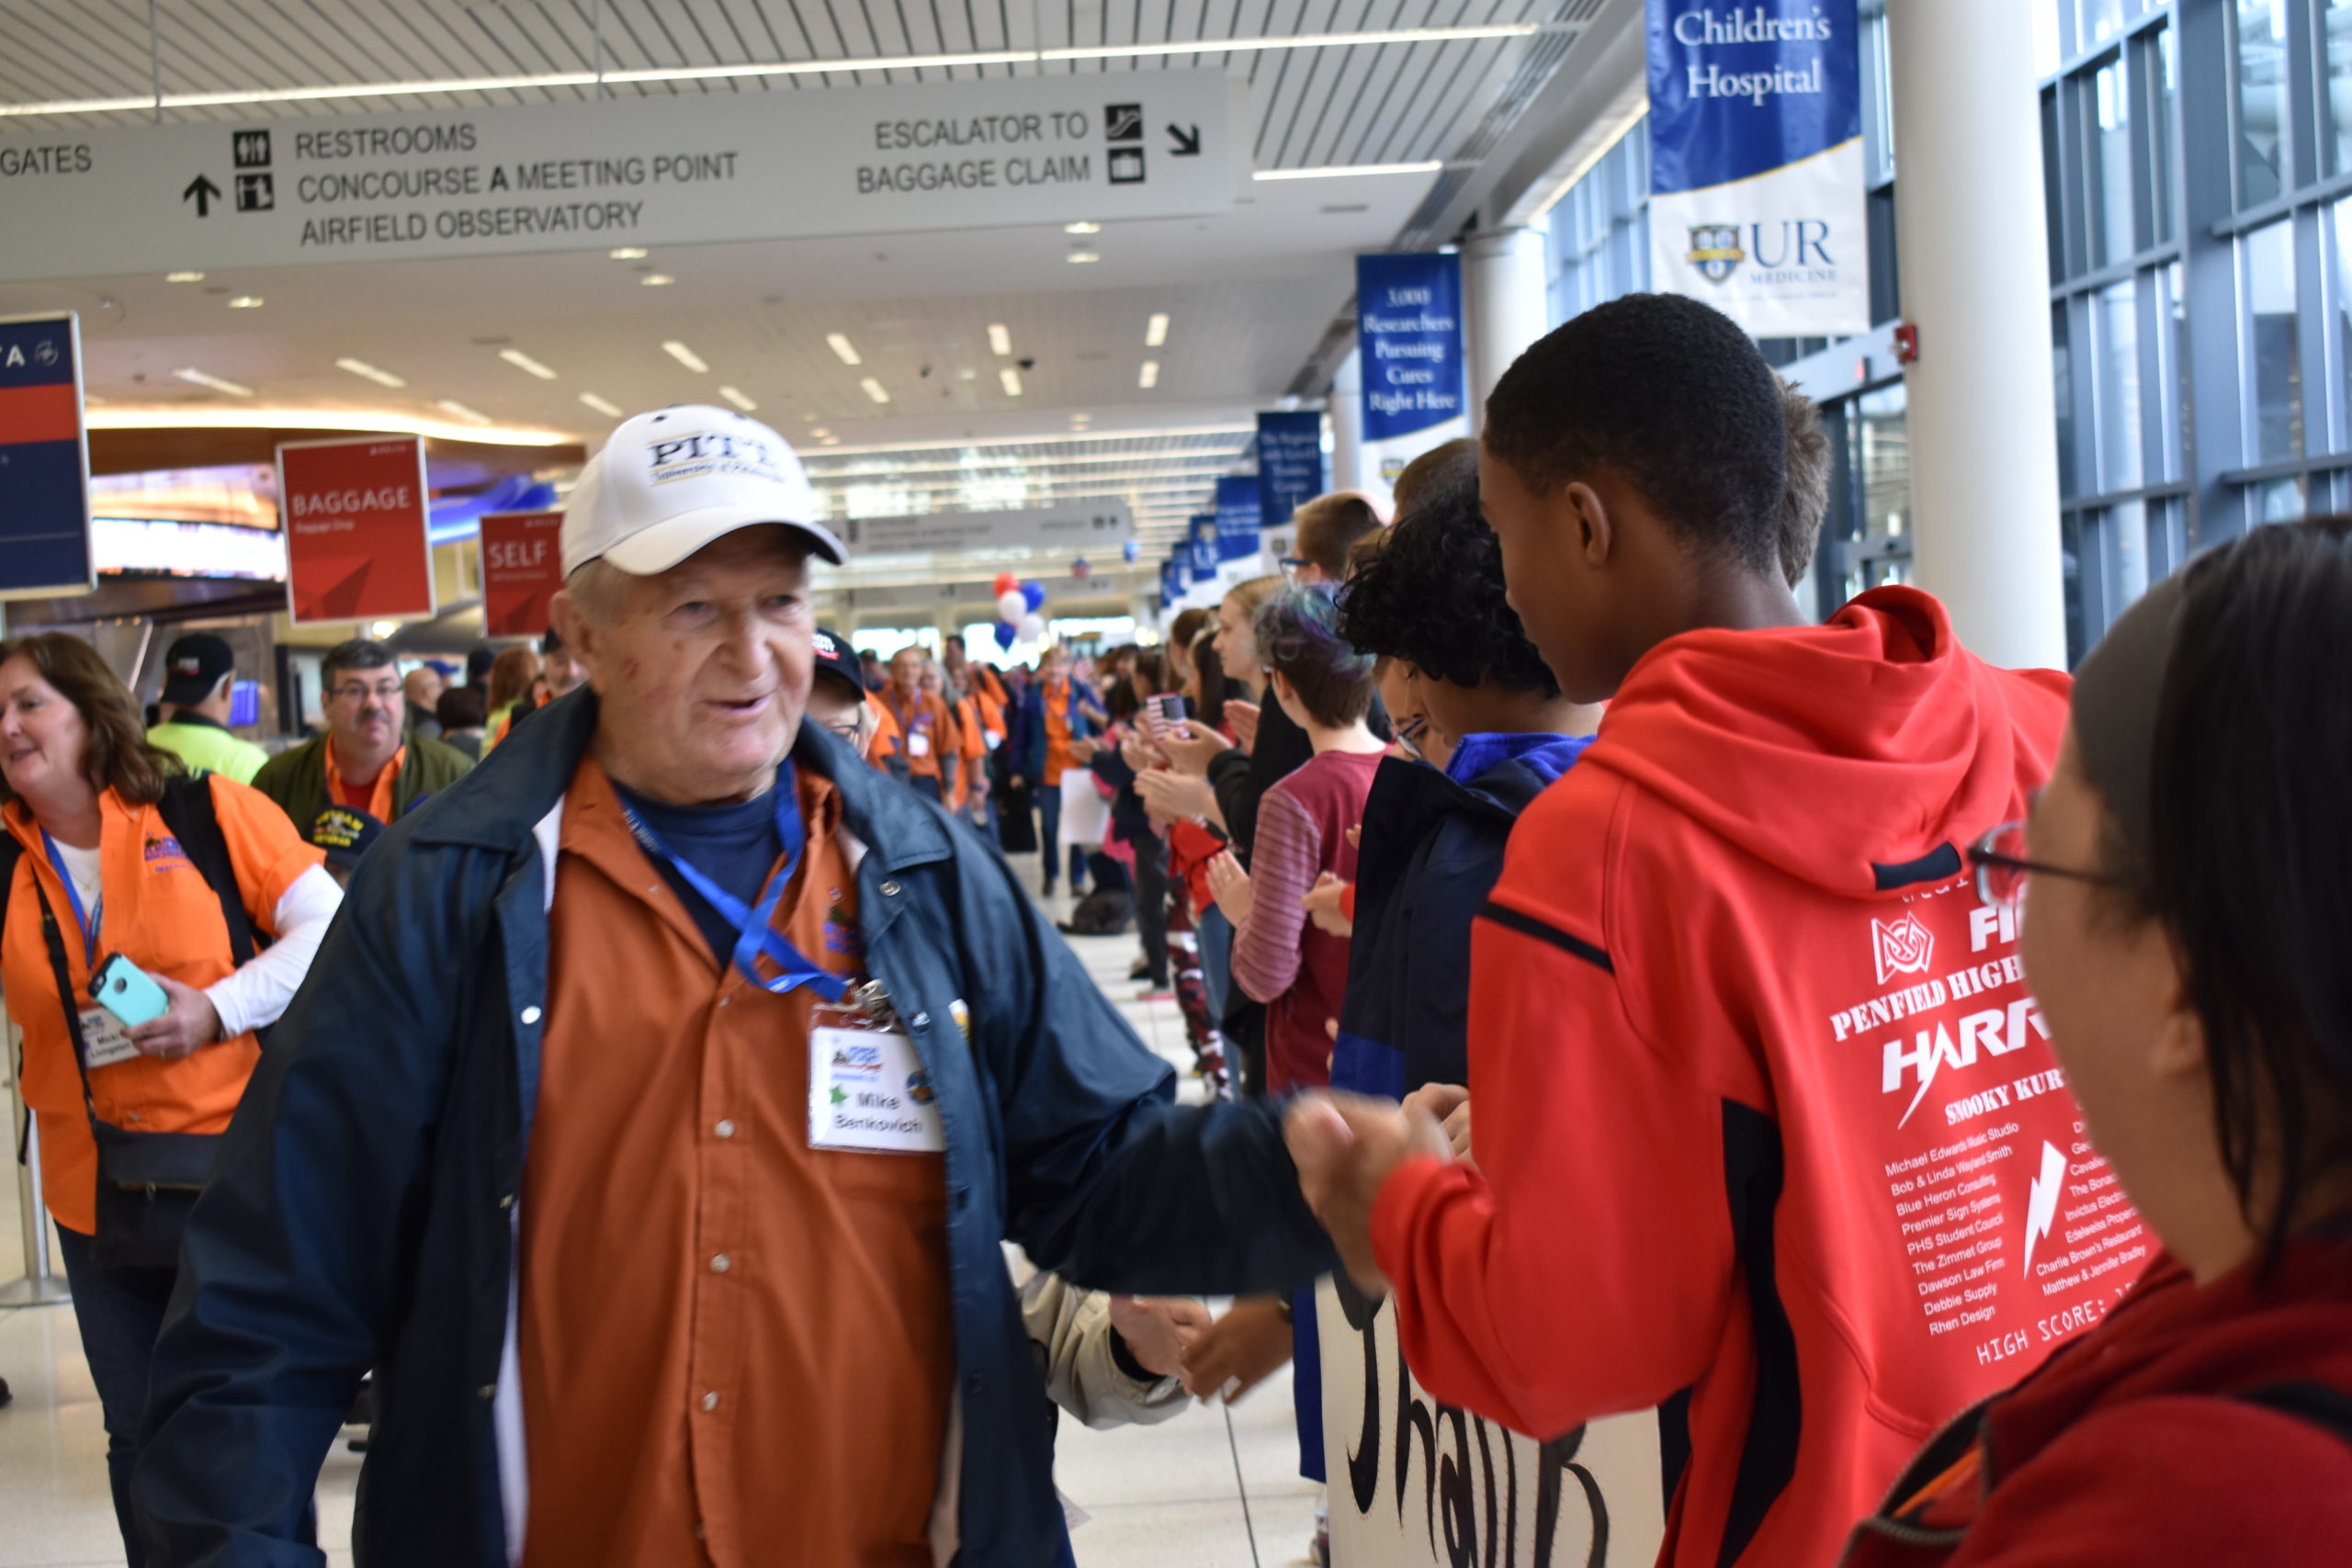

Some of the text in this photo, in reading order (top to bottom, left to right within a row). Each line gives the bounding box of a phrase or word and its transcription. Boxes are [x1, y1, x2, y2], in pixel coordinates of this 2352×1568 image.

[1673, 6, 1832, 46] Children's
[1687, 57, 1822, 107] Hospital
[296, 123, 477, 160] RESTROOMS
[876, 111, 1088, 150] ESCALATOR TO
[0, 144, 93, 177] GATES
[298, 152, 739, 203] CONCOURSE A MEETING POINT
[856, 154, 1091, 194] BAGGAGE CLAIM
[300, 201, 644, 247] AIRFIELD OBSERVATORY
[1749, 220, 1836, 269] UR
[1363, 314, 1454, 333] Researchers
[1374, 340, 1445, 363] Pursuing
[1385, 367, 1434, 385] Cures
[1369, 390, 1457, 416] Right Here
[292, 486, 411, 516] BAGGAGE
[488, 539, 547, 569] SELF
[1829, 979, 1947, 1043] PENFIELD
[1882, 996, 2052, 1130] HARR
[855, 1090, 900, 1111] Mike
[1945, 1067, 2064, 1126] SNOOKY KUR
[1885, 1154, 1928, 1177] Michael
[1929, 1141, 1968, 1162] Edwards
[1987, 1122, 2019, 1141] Studio
[1891, 1179, 1914, 1197] Bob
[1917, 1176, 1926, 1188] &
[1927, 1166, 1955, 1184] Linda
[1985, 1145, 2012, 1163] Smith
[1896, 1199, 1923, 1217] Blue
[1924, 1189, 1956, 1207] Heron
[2069, 1184, 2088, 1198] The
[1901, 1213, 1944, 1235] Premier
[1946, 1205, 1969, 1220] Sign
[1906, 1213, 2004, 1256] PHS Student Council
[1912, 1259, 1935, 1275] The
[1976, 1236, 2002, 1254] Group
[2036, 1224, 2143, 1277] Charlie Brown's Restaurant
[1918, 1258, 2005, 1296] Dawson Law Firm
[2042, 1274, 2081, 1296] Matthew
[2081, 1269, 2089, 1280] &
[1924, 1282, 1997, 1316] Debbie Supply
[1928, 1305, 1996, 1336] Rhen Design
[1976, 1299, 2107, 1366] HIGH SCORE:
